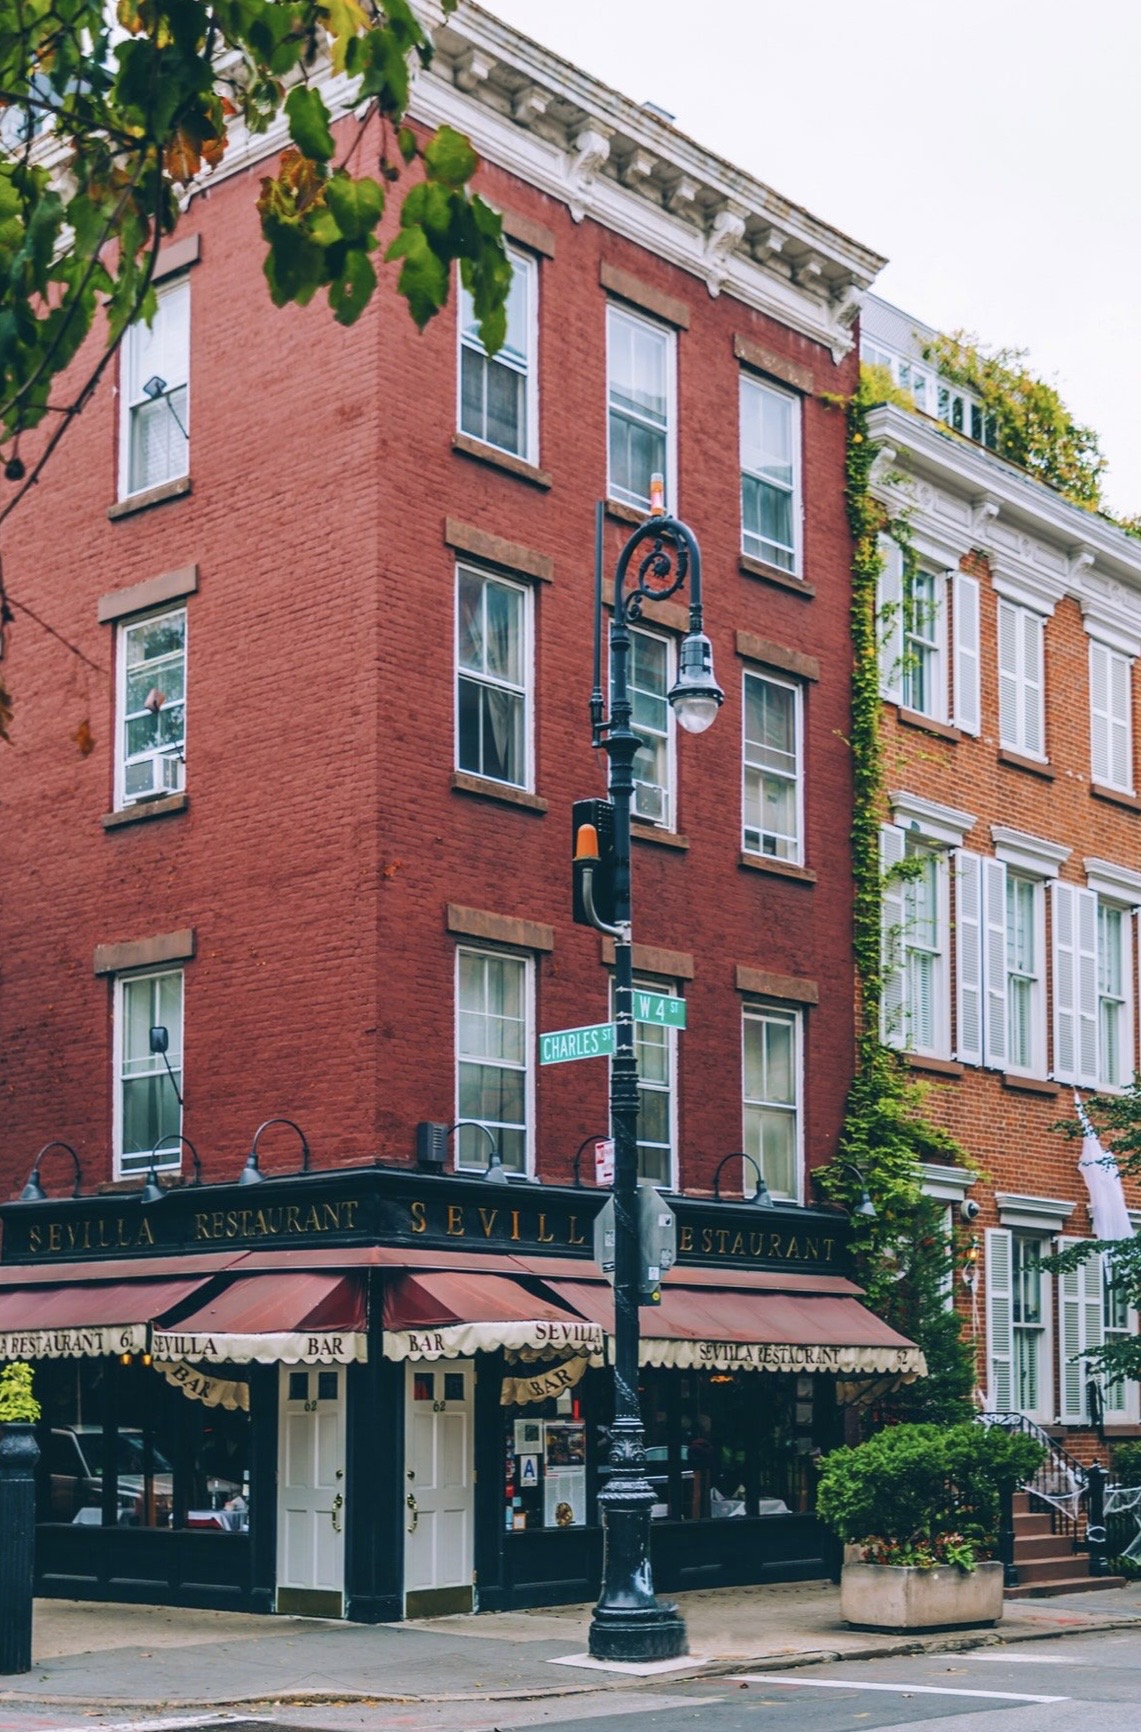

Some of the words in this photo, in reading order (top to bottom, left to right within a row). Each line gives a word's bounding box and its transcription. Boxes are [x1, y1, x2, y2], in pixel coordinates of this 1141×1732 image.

[639, 996, 650, 1018] W
[655, 1000, 665, 1021] 4
[670, 1002, 679, 1014] ST
[543, 1030, 599, 1060] CHARLES
[602, 1028, 611, 1042] ST
[30, 1217, 155, 1251] SEVILLA
[195, 1201, 359, 1240] RESTAURANT
[411, 1202, 584, 1244] SEVILL
[680, 1226, 835, 1261] ESTAURANT
[11, 1333, 104, 1354] RESTAURANT
[154, 1335, 218, 1356] SEVILLA
[307, 1337, 345, 1355] BAR
[409, 1334, 445, 1352] BAR
[536, 1323, 600, 1343] SEVILLA
[699, 1344, 754, 1362] SEVILLA
[896, 1350, 908, 1365] 62
[171, 1367, 211, 1398] BAR
[530, 1369, 572, 1396] BAR
[304, 1401, 317, 1412] 62
[433, 1401, 446, 1412] 62
[523, 1459, 535, 1477] A
